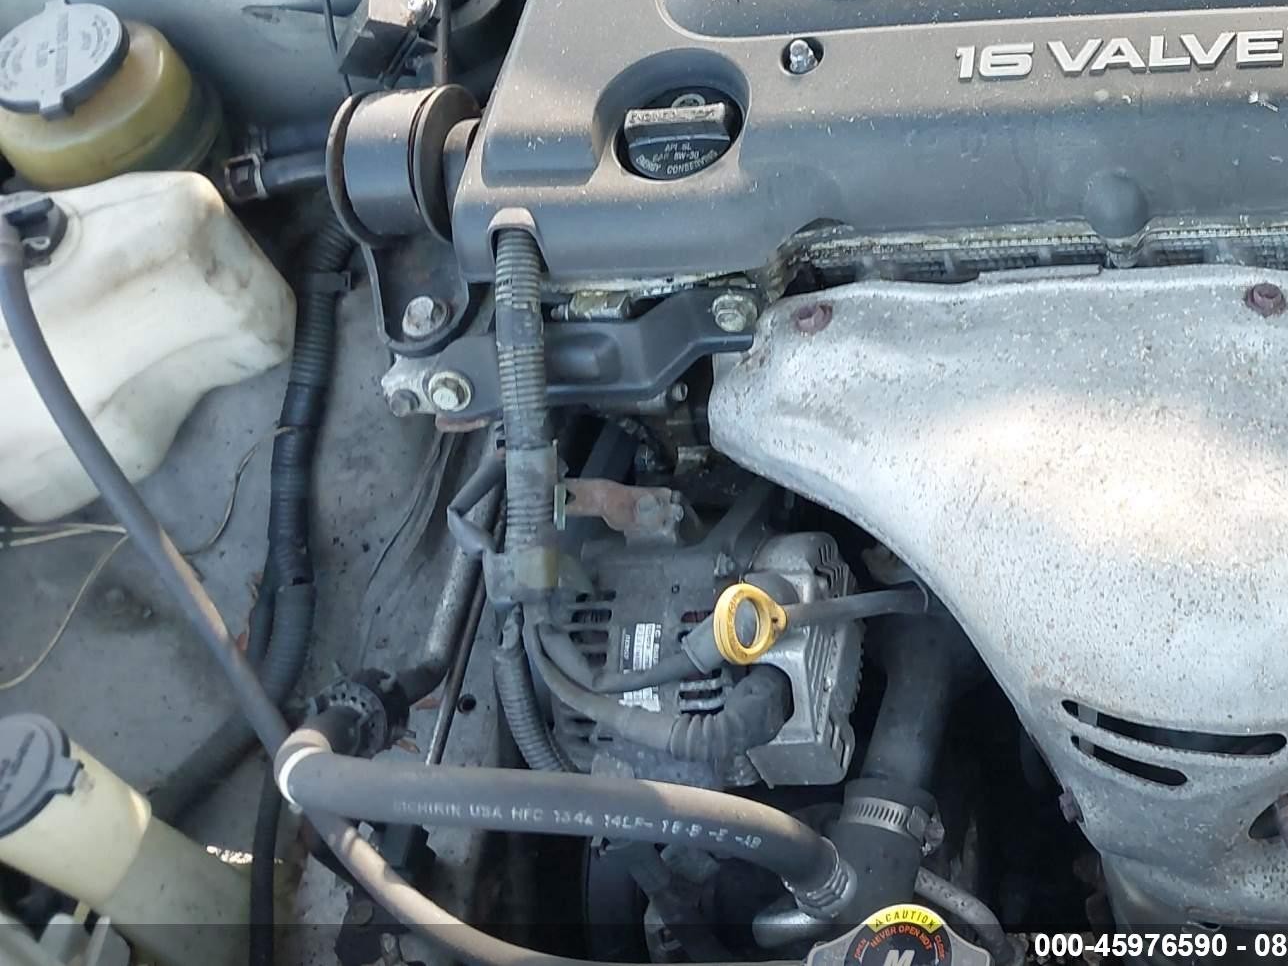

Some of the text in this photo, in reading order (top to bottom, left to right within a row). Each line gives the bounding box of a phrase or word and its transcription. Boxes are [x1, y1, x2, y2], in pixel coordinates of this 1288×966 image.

[955, 28, 1285, 82] 16 VALVE
[469, 803, 503, 820] USA
[885, 909, 937, 929] CAUTION
[898, 925, 920, 937] OPEN
